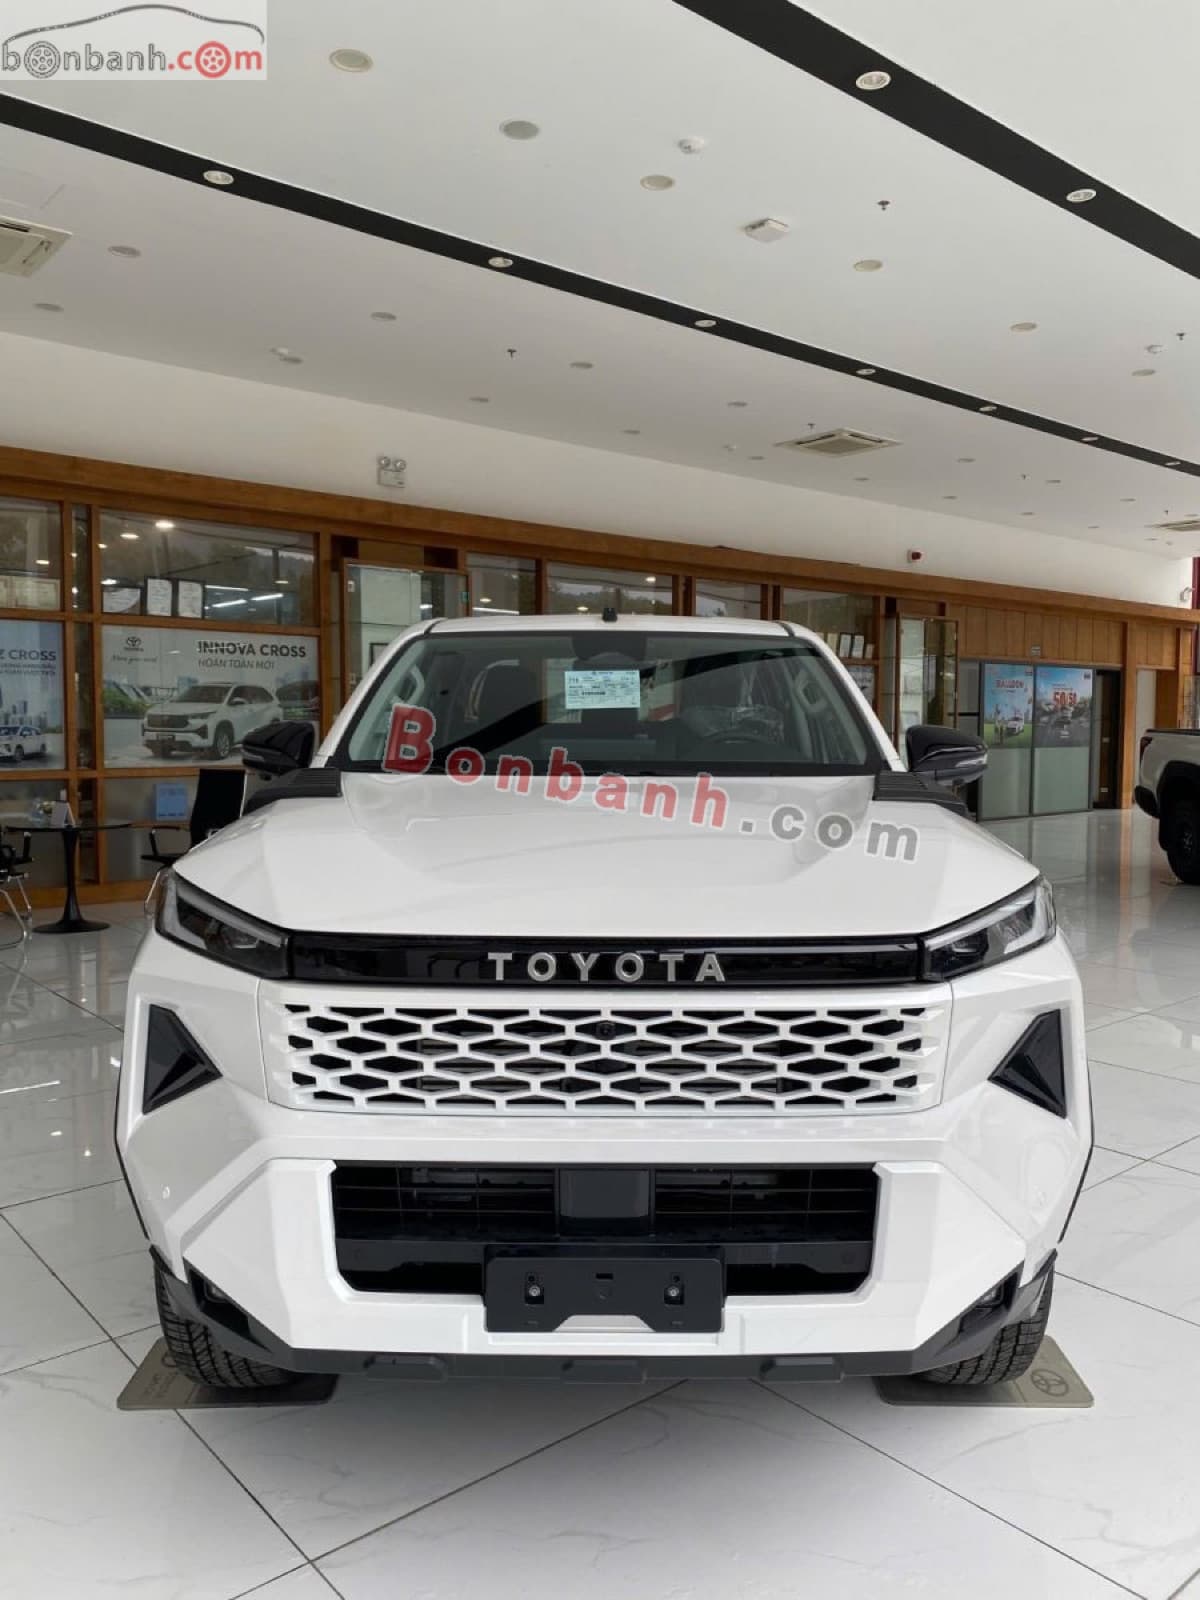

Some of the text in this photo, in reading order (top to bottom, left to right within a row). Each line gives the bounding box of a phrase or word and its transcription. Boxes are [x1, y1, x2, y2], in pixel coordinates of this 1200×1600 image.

[8, 649, 57, 661] CROSS
[197, 641, 306, 657] INNOVA CROSS
[487, 951, 726, 982] TOYOTA
